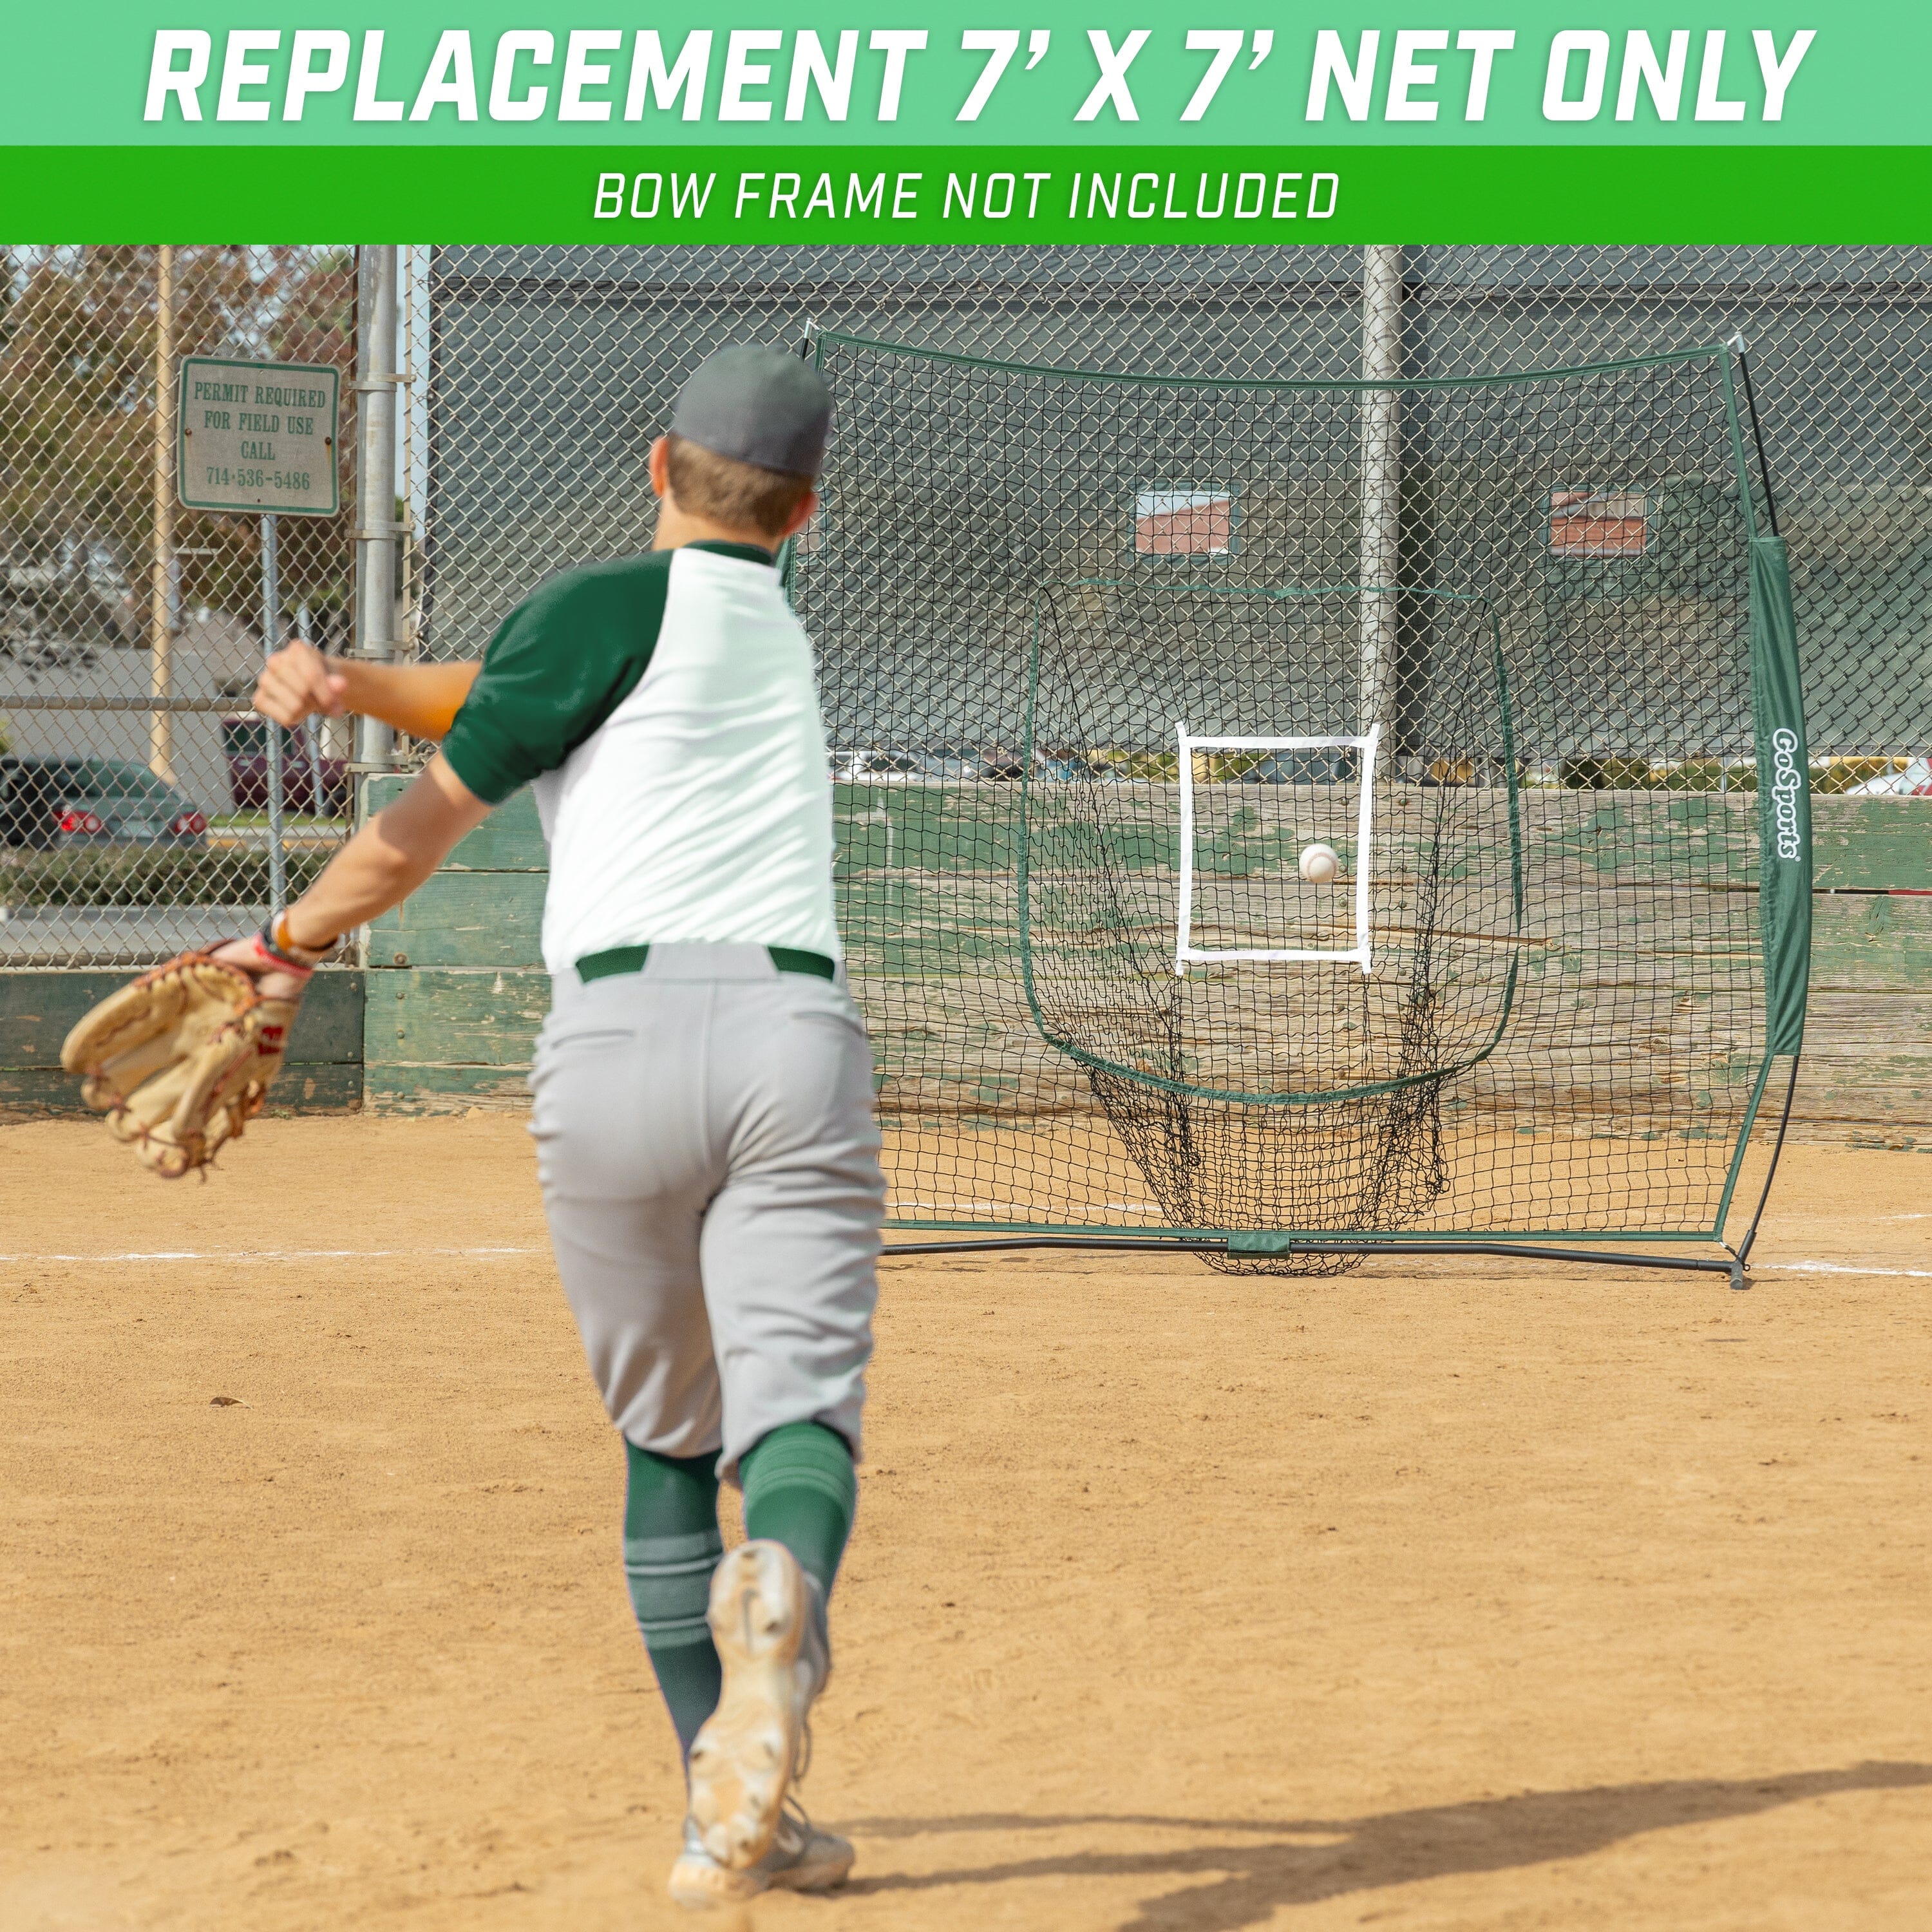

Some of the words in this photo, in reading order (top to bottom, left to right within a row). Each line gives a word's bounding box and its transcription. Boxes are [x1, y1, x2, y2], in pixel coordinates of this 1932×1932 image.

[194, 382, 248, 402] PERMIT
[254, 386, 326, 408] REQUIRED
[204, 410, 230, 430] FOR
[238, 413, 279, 432] FIELD
[287, 416, 314, 435] USE
[240, 440, 276, 460] CALL
